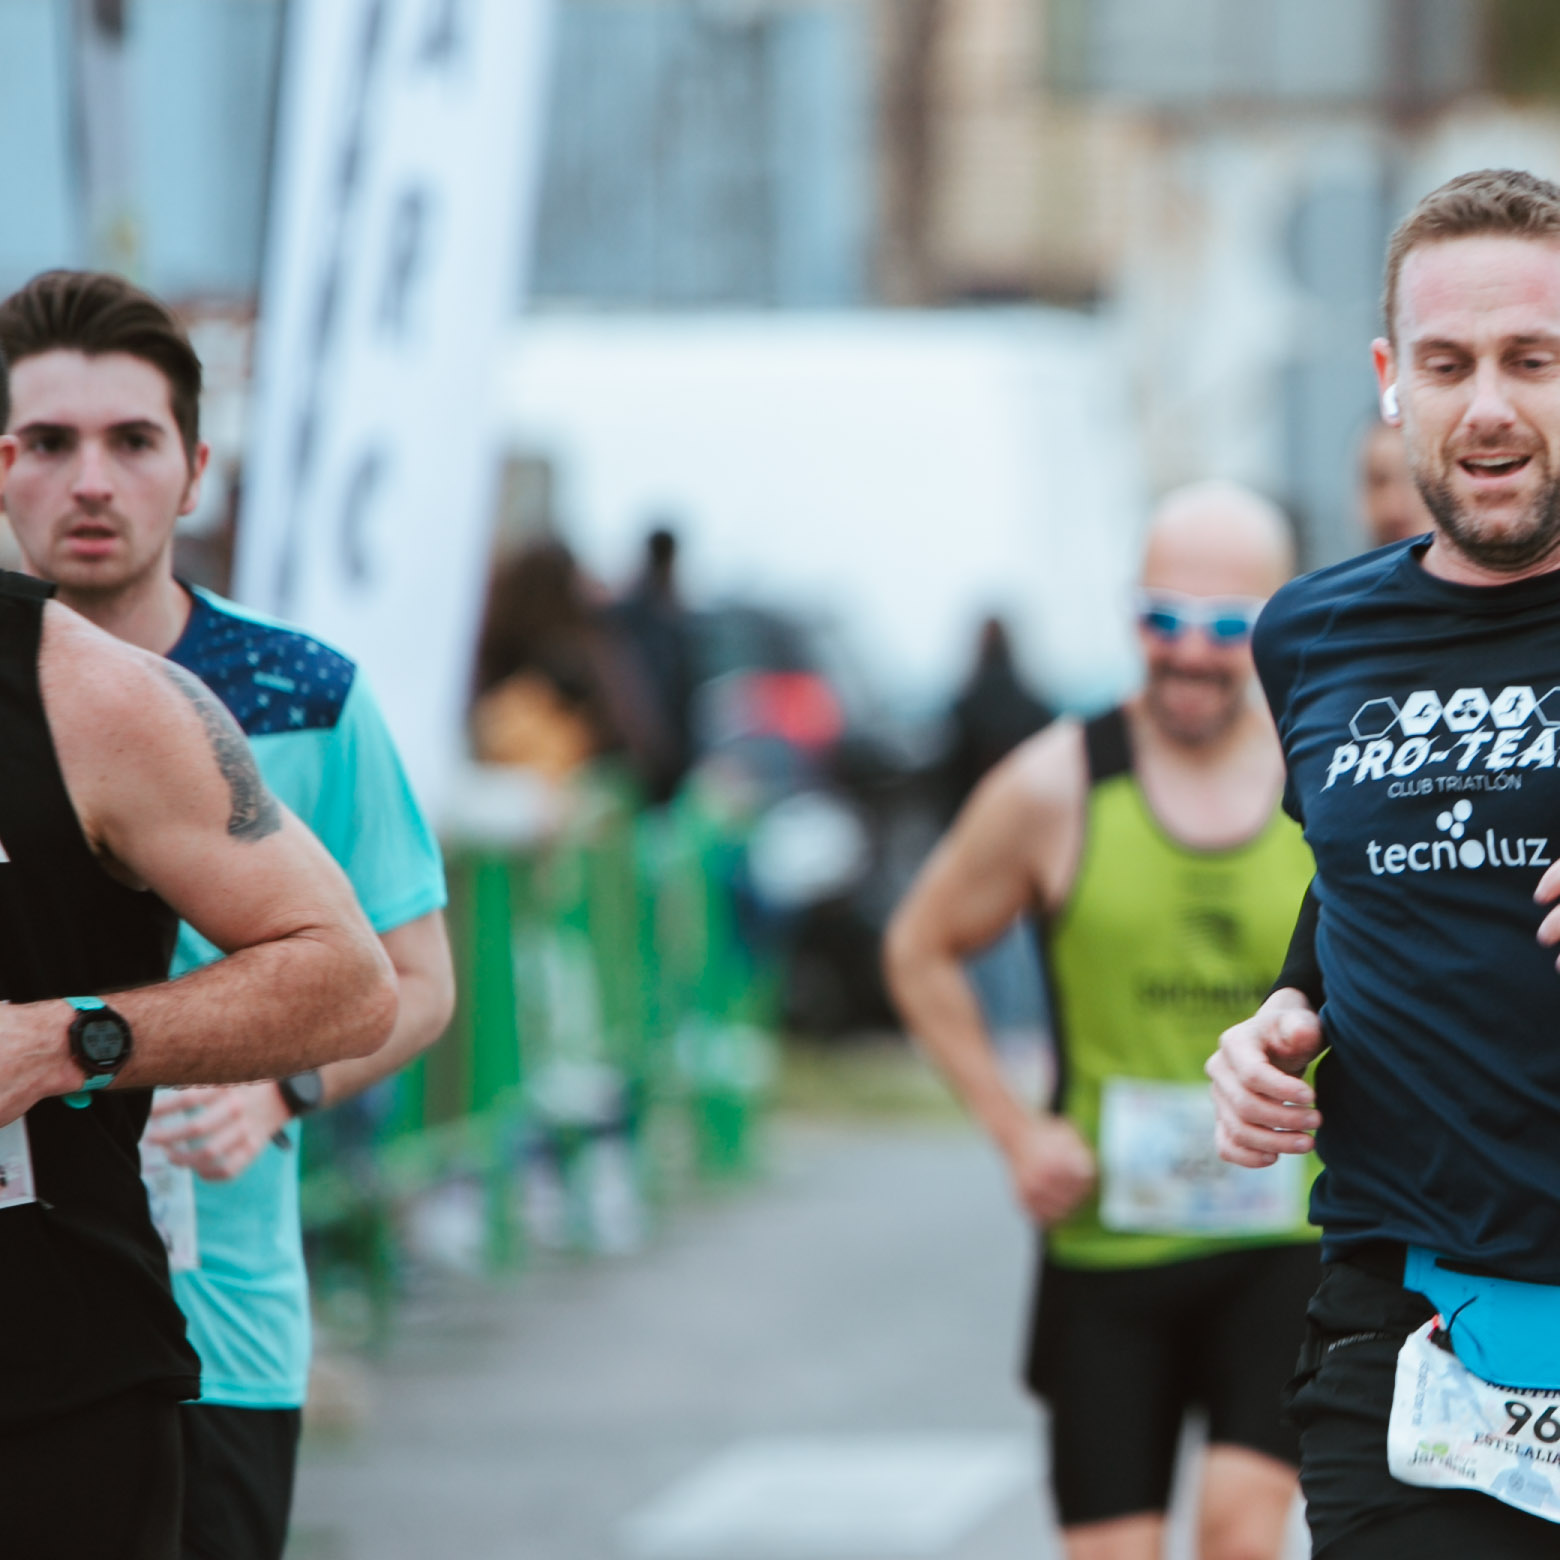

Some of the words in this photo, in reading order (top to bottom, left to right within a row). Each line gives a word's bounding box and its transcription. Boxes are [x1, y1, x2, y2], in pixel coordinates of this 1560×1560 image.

[1387, 777, 1433, 798] CLUB
[1435, 771, 1522, 793] TRIATLÓN
[1365, 828, 1552, 876] tecnoluz
